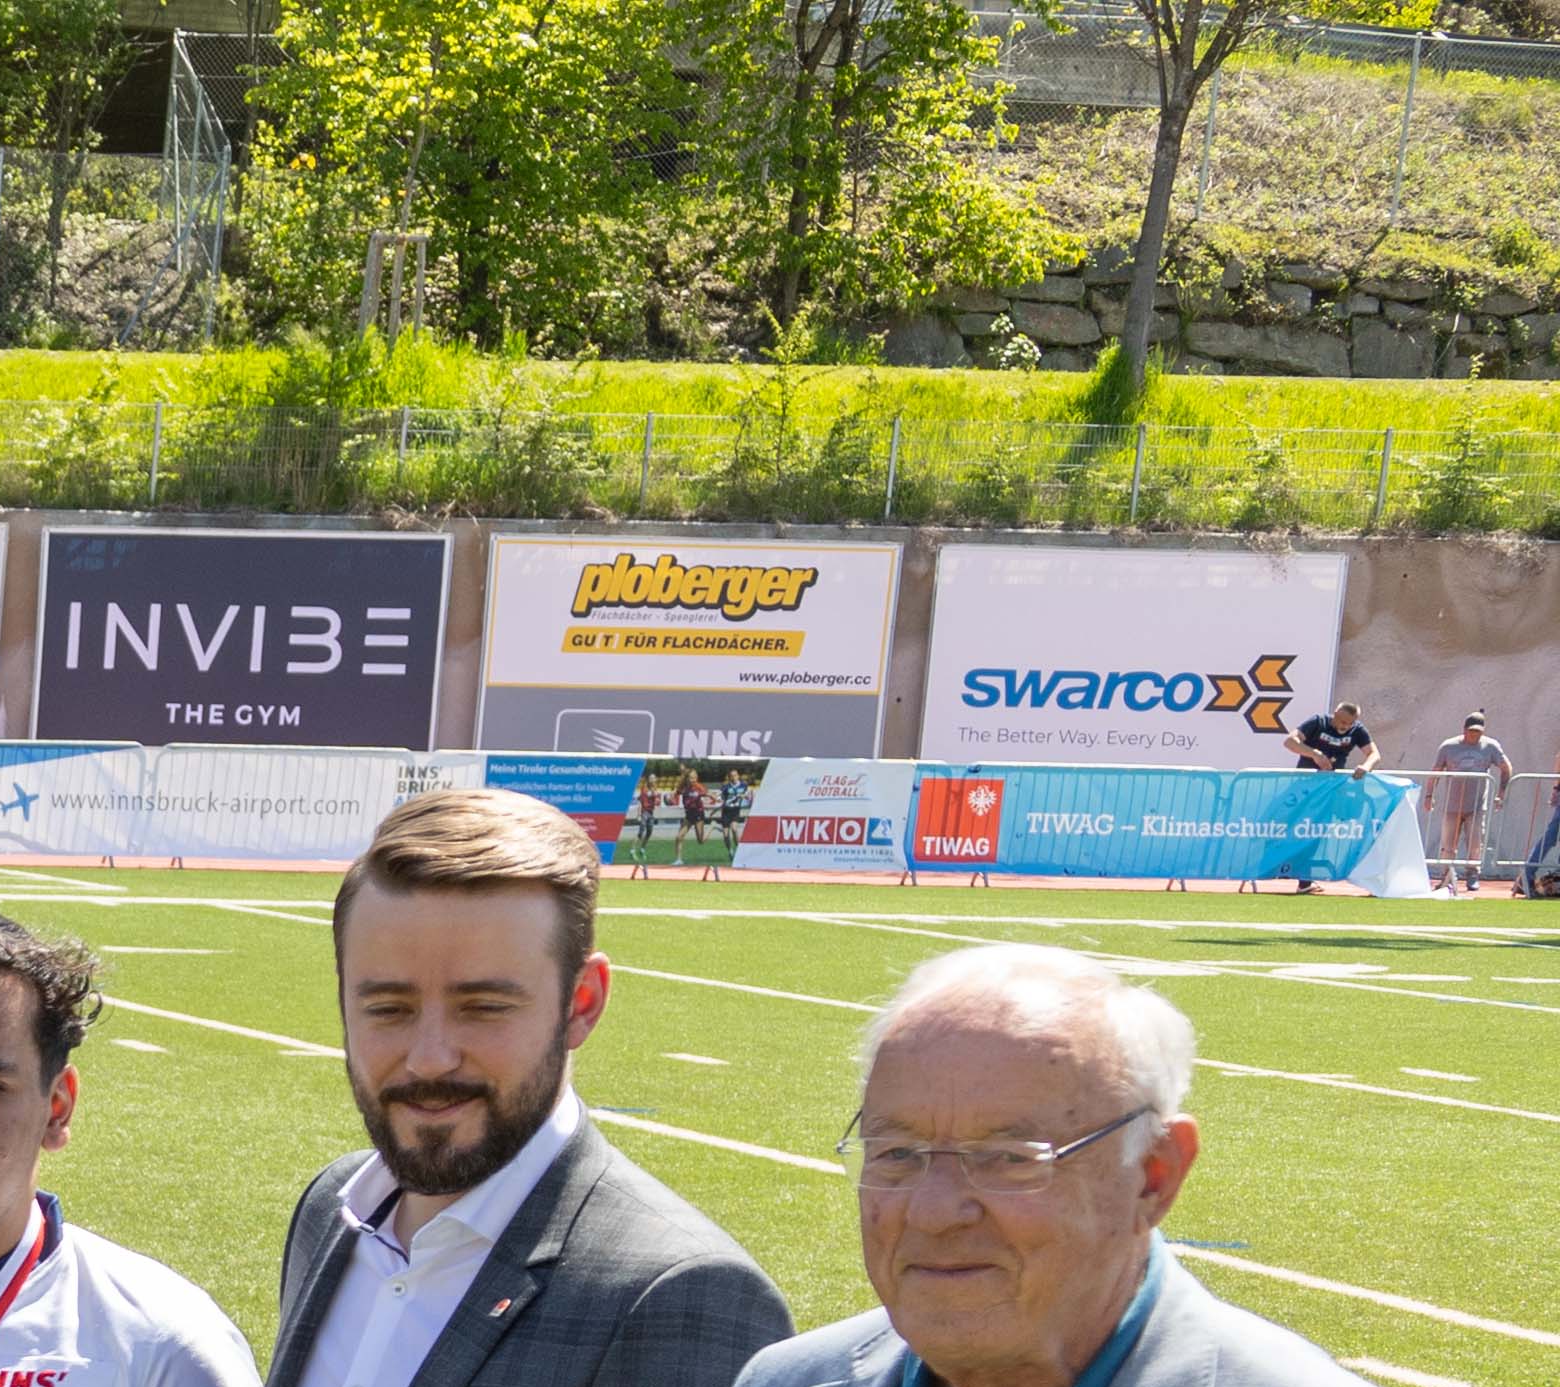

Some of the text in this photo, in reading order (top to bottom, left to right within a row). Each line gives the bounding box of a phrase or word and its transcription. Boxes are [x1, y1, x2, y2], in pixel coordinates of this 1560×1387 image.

[572, 553, 817, 621] ploberger
[591, 610, 719, 624] Flachdächer Spenglerei
[65, 601, 412, 676] INVIBE
[624, 631, 790, 652] FÜR FLACHDÄCHER.
[739, 670, 872, 687] www.ploberger.cc
[961, 667, 1205, 713] swarco
[165, 702, 302, 727] THE GYM
[669, 728, 773, 757] INNS'
[958, 726, 1200, 750] The Better Way. Every Day.
[397, 765, 442, 779] INNS'
[489, 763, 633, 777] Meine Tiroler Gesundheitsberufe
[821, 775, 848, 786] FLAG
[808, 786, 858, 797] FOOTBALL
[50, 790, 361, 820] www.innsbruck-airport.com
[781, 819, 862, 842] WKO
[1026, 811, 1115, 837] TIWAG
[1141, 814, 1287, 840] Klimaschutz
[1293, 816, 1365, 840] durch
[922, 834, 990, 858] TIWAG
